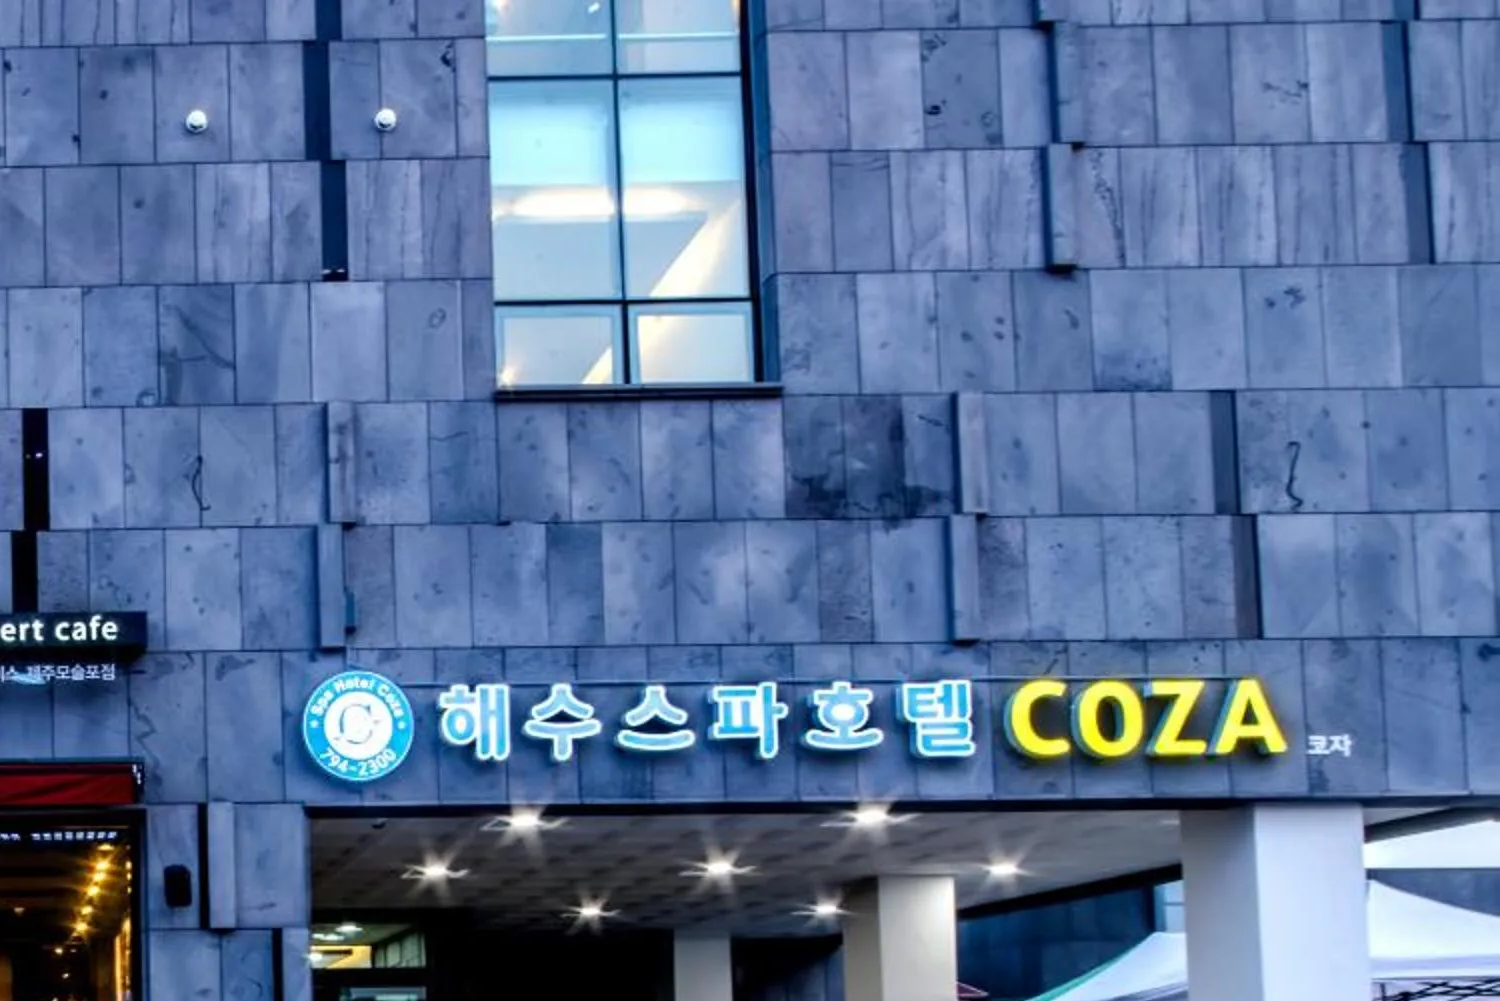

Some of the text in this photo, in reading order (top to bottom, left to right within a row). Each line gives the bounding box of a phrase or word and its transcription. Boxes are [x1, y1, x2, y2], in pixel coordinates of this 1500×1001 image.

[54, 614, 119, 641] cafe
[1004, 679, 1288, 759] COZA
[1308, 735, 1352, 755] 코자
